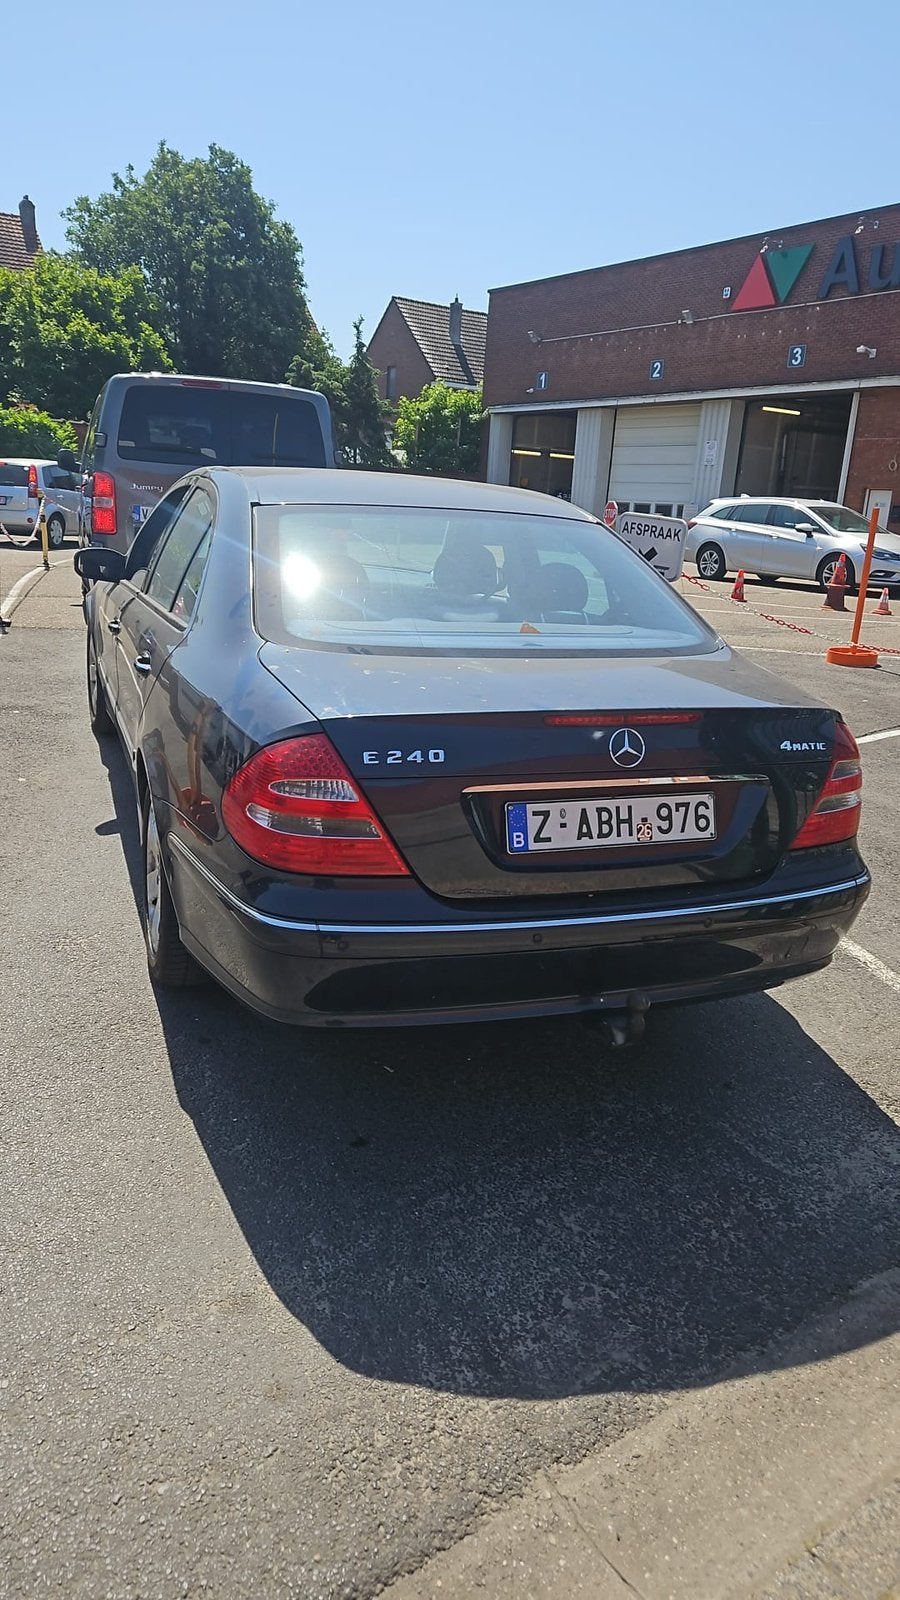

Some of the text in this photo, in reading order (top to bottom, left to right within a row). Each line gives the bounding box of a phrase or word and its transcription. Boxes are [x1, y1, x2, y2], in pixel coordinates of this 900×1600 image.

[791, 347, 802, 365] 3
[652, 362, 661, 378] 2
[539, 372, 546, 388] 1
[604, 508, 617, 518] STOP
[621, 521, 682, 542] AFSPRAAK
[780, 740, 827, 751] 4MATIC
[363, 749, 445, 764] E 240
[637, 823, 652, 839] 26
[512, 832, 525, 848] B
